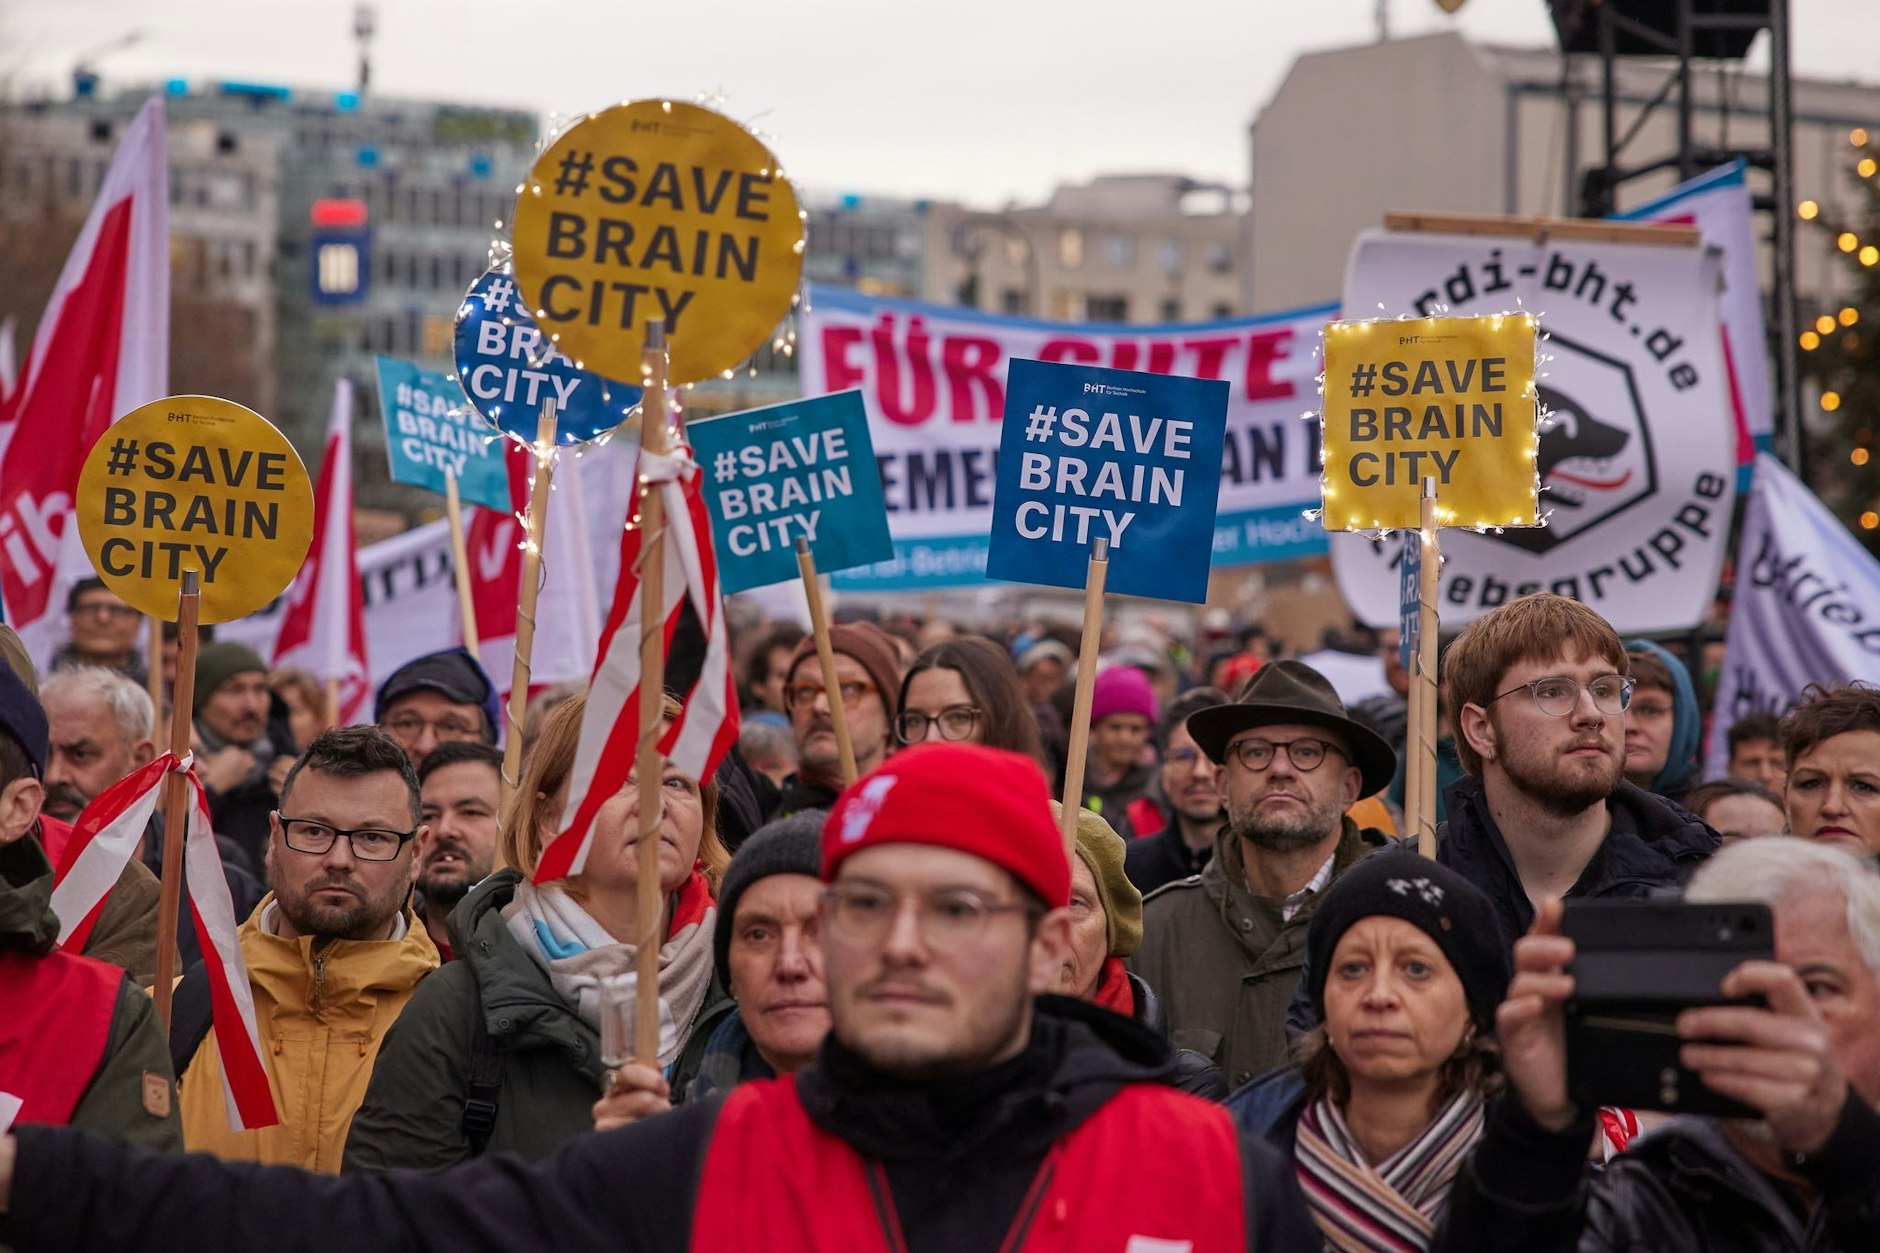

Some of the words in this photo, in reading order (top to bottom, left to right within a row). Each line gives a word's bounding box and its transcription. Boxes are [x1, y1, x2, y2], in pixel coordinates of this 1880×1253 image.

[554, 150, 773, 222] #SAVE
[546, 211, 760, 282] BRAIN
[539, 274, 695, 335] CITY
[471, 364, 581, 410] CITY
[821, 310, 1004, 427] FÜR
[1083, 383, 1106, 395] BHT
[1350, 358, 1506, 398] #SAVE
[168, 411, 191, 424] BHT
[397, 409, 488, 458] BRAIN
[1025, 404, 1193, 459] #SAVE
[1350, 403, 1503, 442] BRAIN
[107, 438, 286, 490] #SAVE
[402, 438, 468, 476] CITY
[714, 427, 848, 483] #SAVE
[1020, 452, 1184, 506] BRAIN
[1349, 450, 1460, 487] CITY
[104, 487, 278, 540] BRAIN
[719, 465, 852, 520] BRAIN
[728, 510, 820, 556] CITY
[1015, 501, 1136, 549] CITY
[101, 538, 228, 583] CITY
